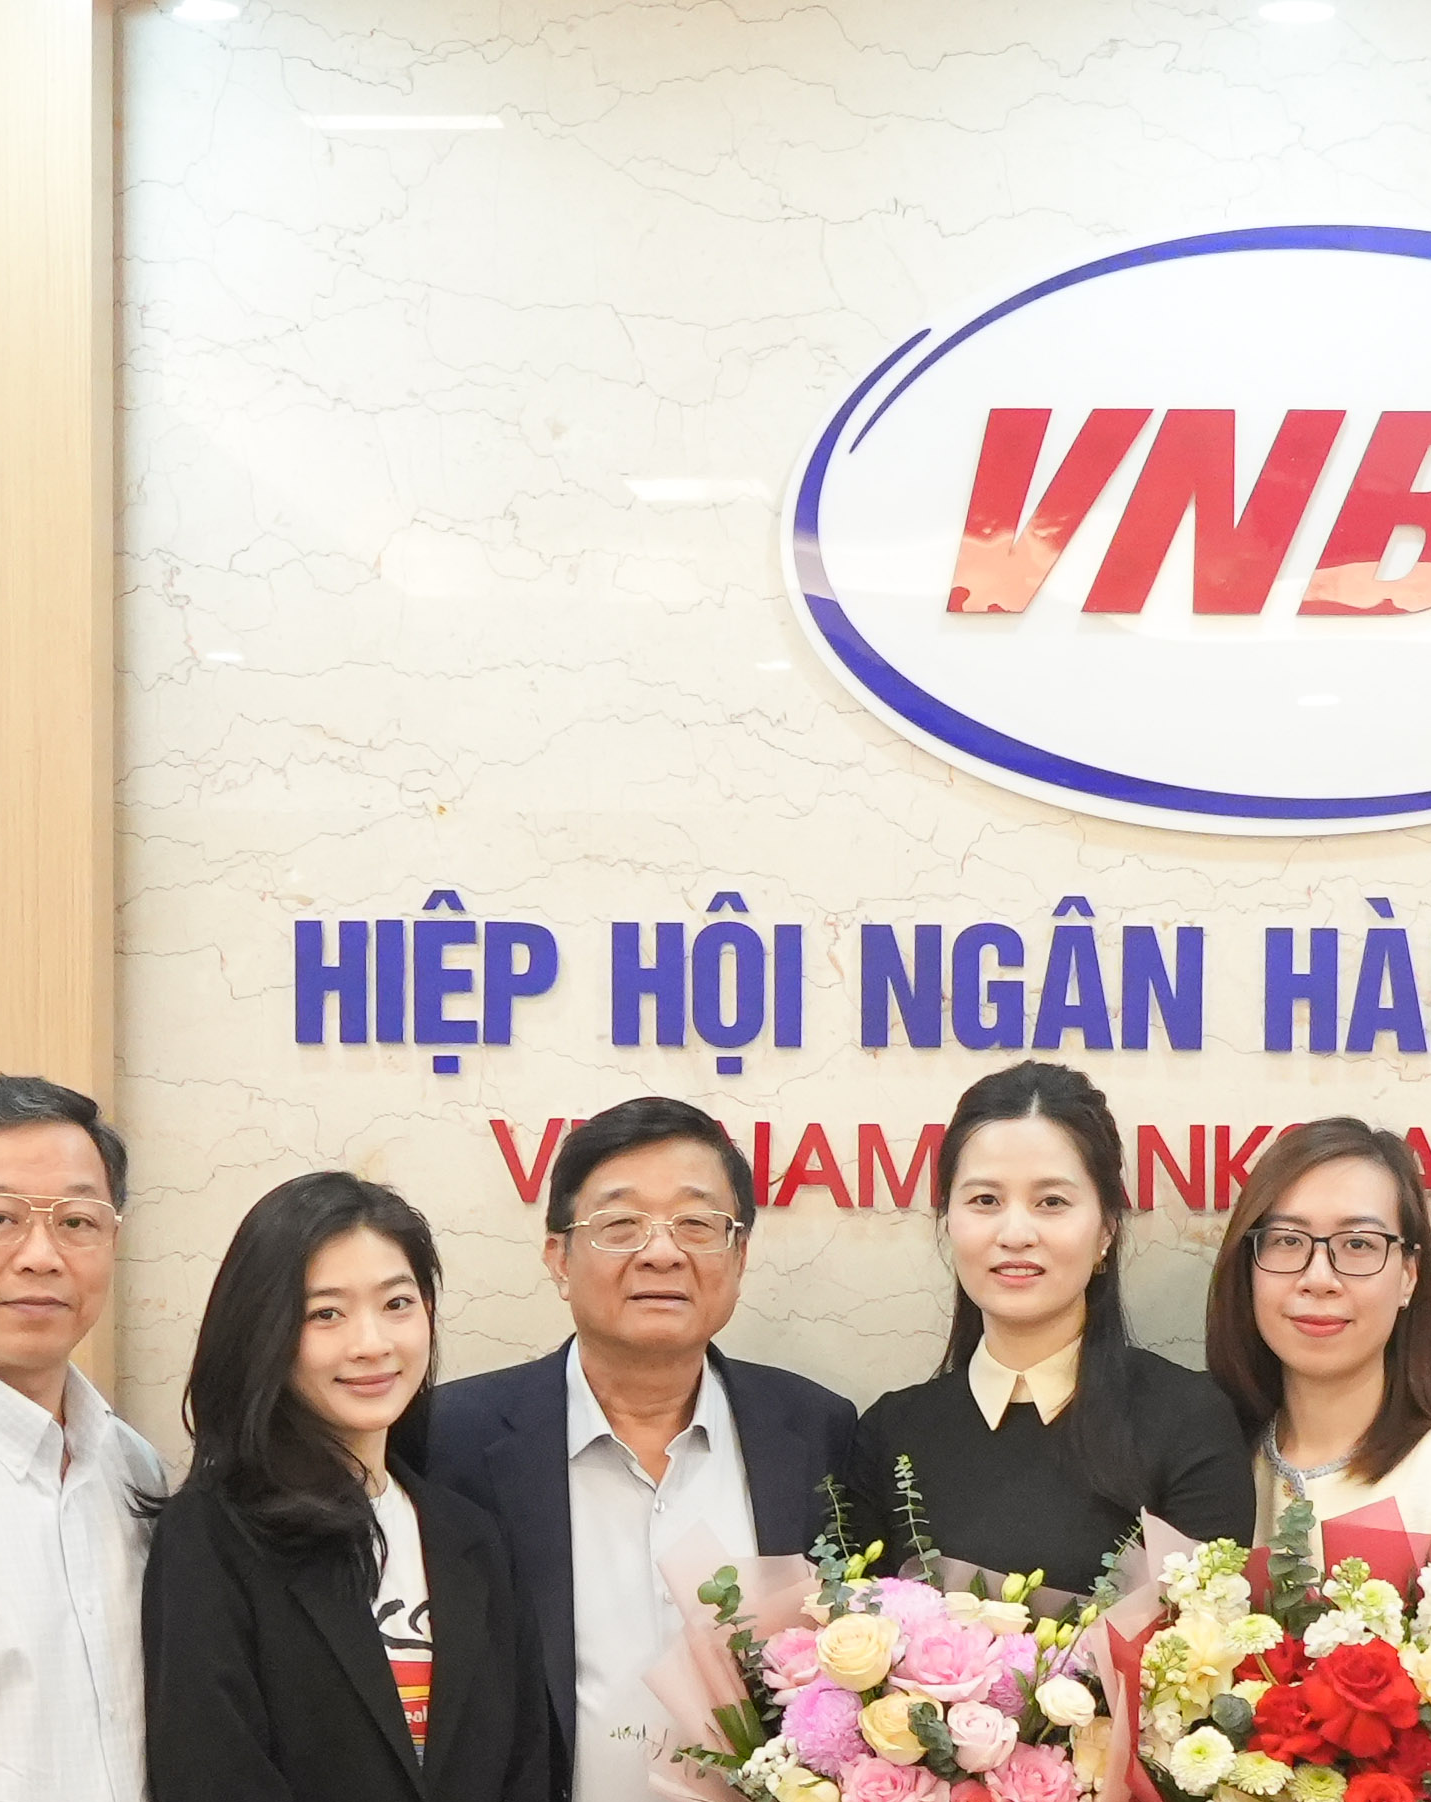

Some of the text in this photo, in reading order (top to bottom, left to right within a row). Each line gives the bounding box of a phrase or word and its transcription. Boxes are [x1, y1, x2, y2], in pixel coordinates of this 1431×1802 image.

[294, 889, 559, 1075] HIỆP
[611, 891, 803, 1075] HỘI
[860, 895, 1204, 1051] NGÂN
